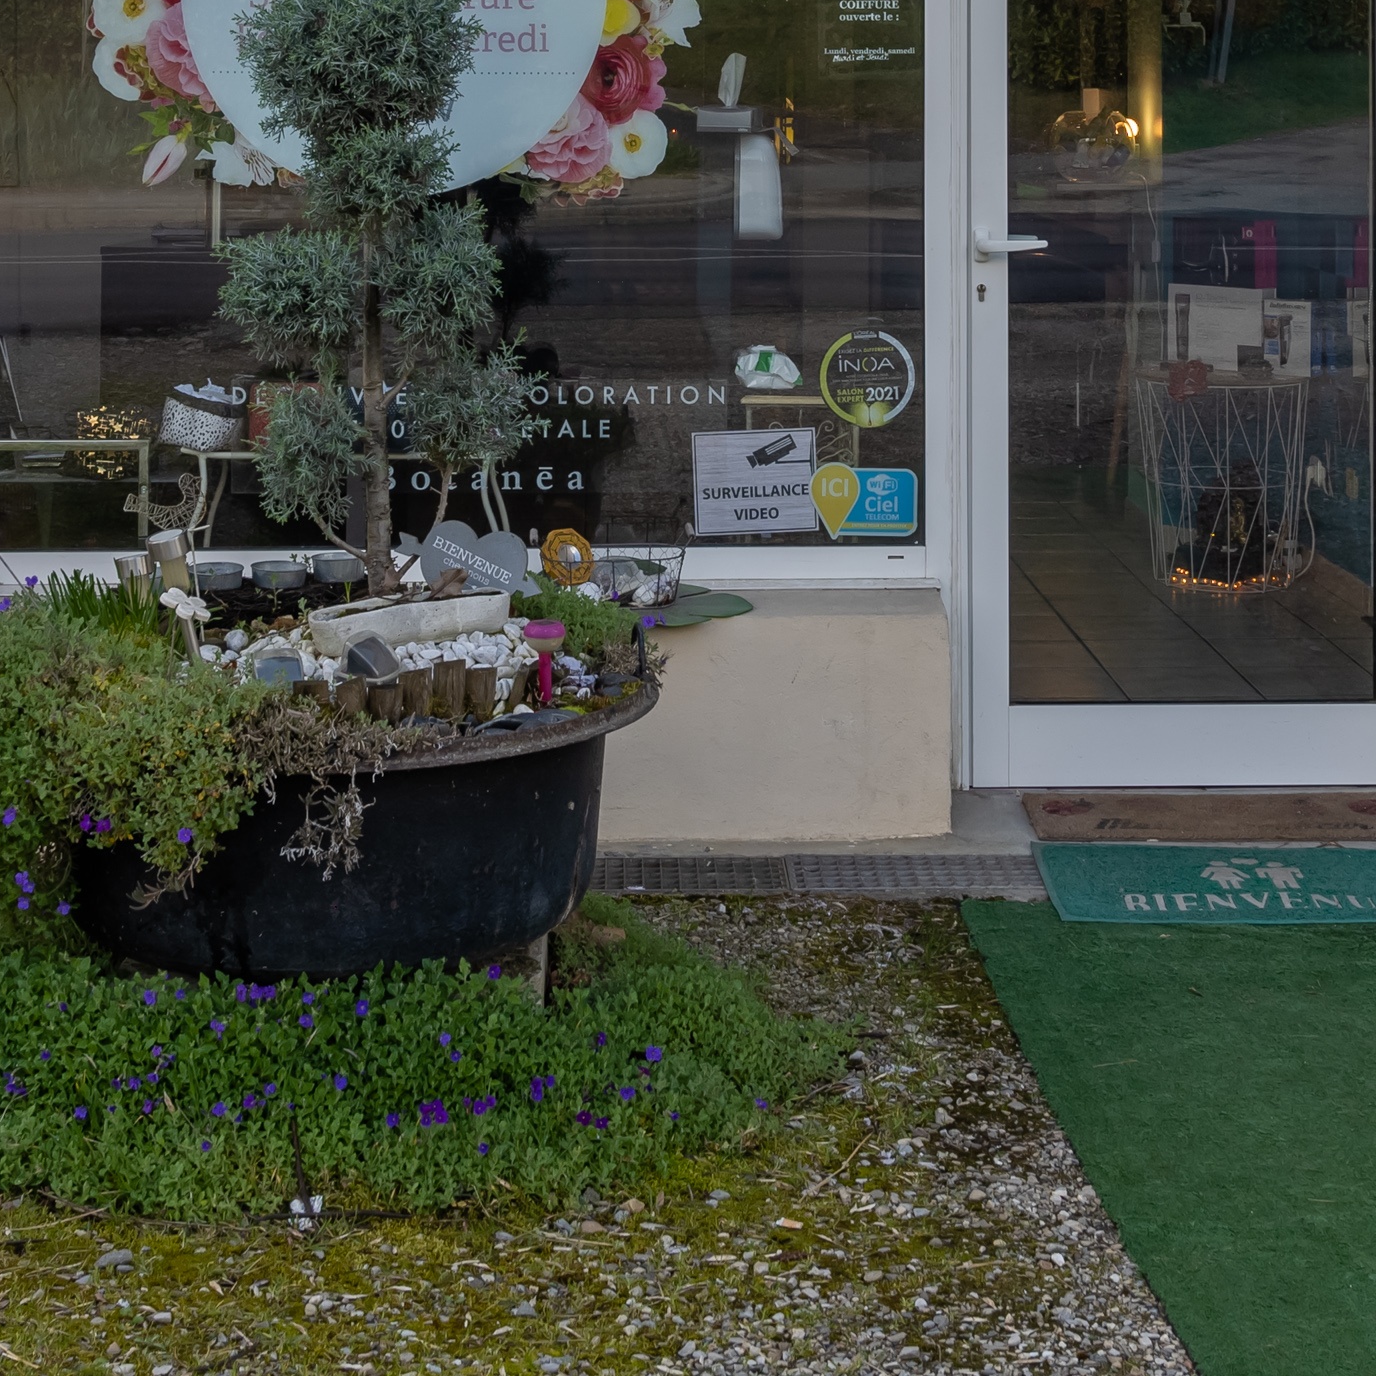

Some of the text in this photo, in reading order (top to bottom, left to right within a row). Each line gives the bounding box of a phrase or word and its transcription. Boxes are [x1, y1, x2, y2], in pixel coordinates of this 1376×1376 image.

[839, 0, 900, 10] COIFFURE
[839, 12, 881, 22] ouverte
[883, 11, 894, 22] le
[824, 47, 849, 56] Lundi,
[887, 47, 916, 55] samedi
[530, 385, 728, 406] OLORATION
[836, 388, 864, 396] SALON
[836, 395, 865, 403] EXPERT
[865, 386, 900, 402] 2021
[522, 419, 612, 439] TALE
[702, 483, 810, 500] SURVEILLANCE
[821, 477, 850, 498] ICI
[865, 495, 899, 513] Ciel
[733, 507, 780, 521] VIDEO
[865, 513, 900, 521] TELECOM
[432, 535, 513, 584] BIENVENUE
[467, 569, 490, 586] nous
